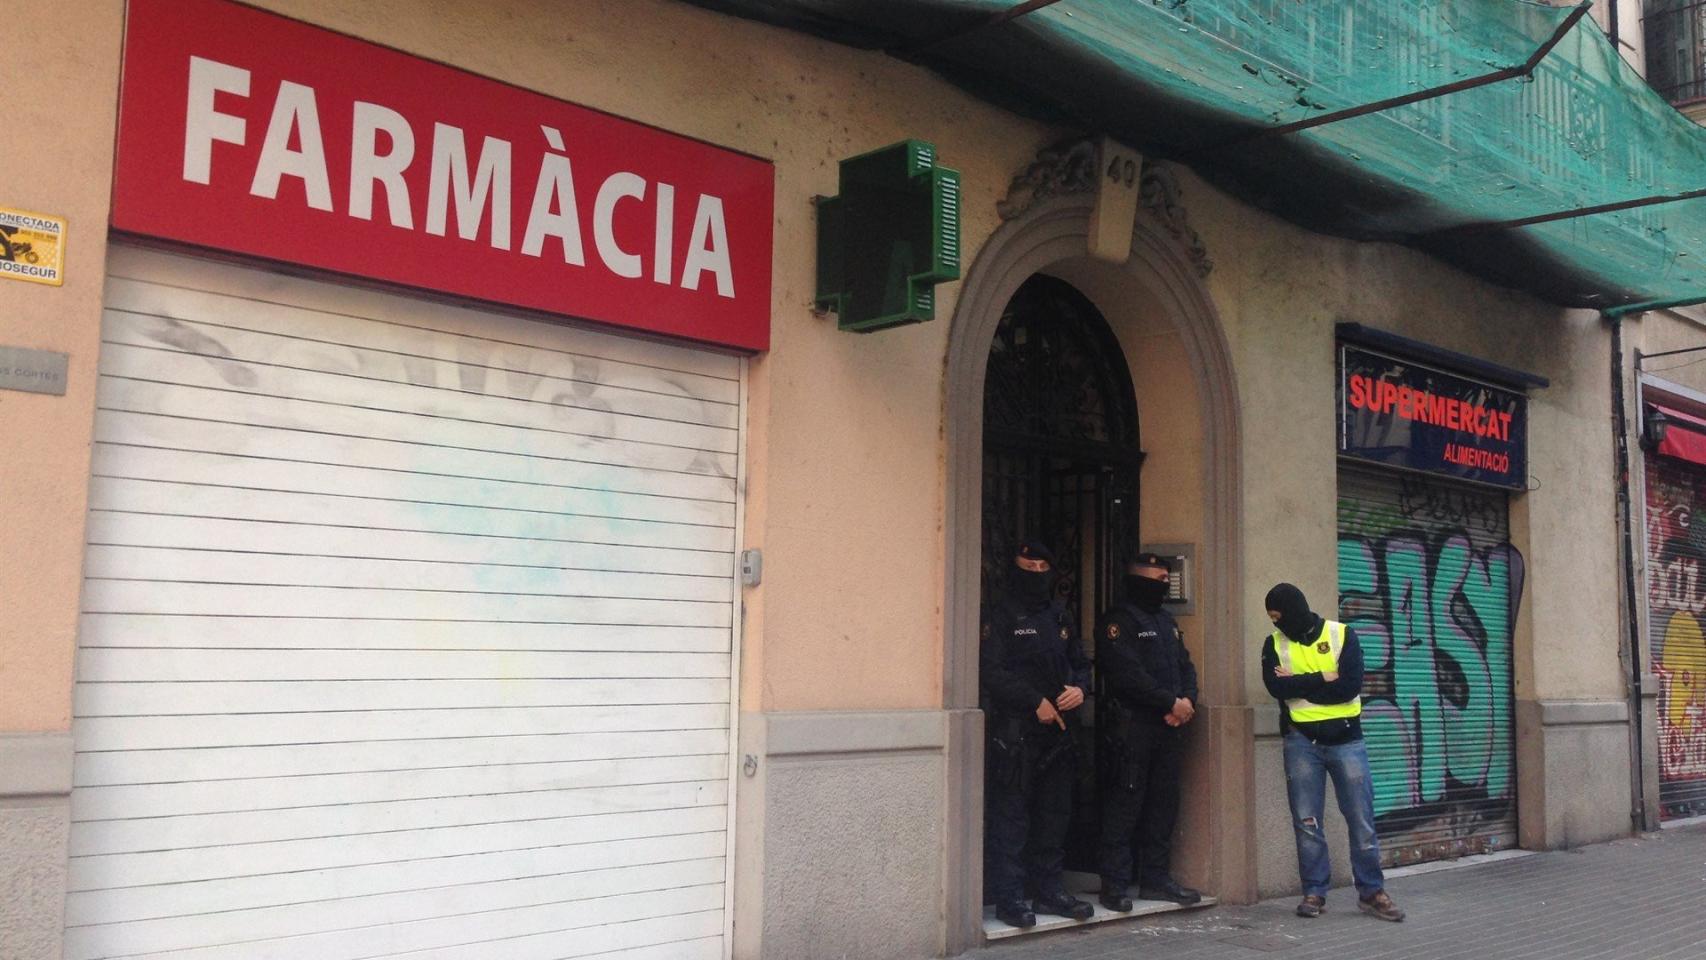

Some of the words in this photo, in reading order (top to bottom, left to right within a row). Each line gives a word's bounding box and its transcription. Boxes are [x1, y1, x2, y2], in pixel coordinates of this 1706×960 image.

[183, 55, 735, 298] FARMÀCIA
[1107, 155, 1136, 188] 40
[1350, 374, 1512, 442] SUPERMERCAT
[1443, 442, 1509, 474] ALIMENTACIÓ
